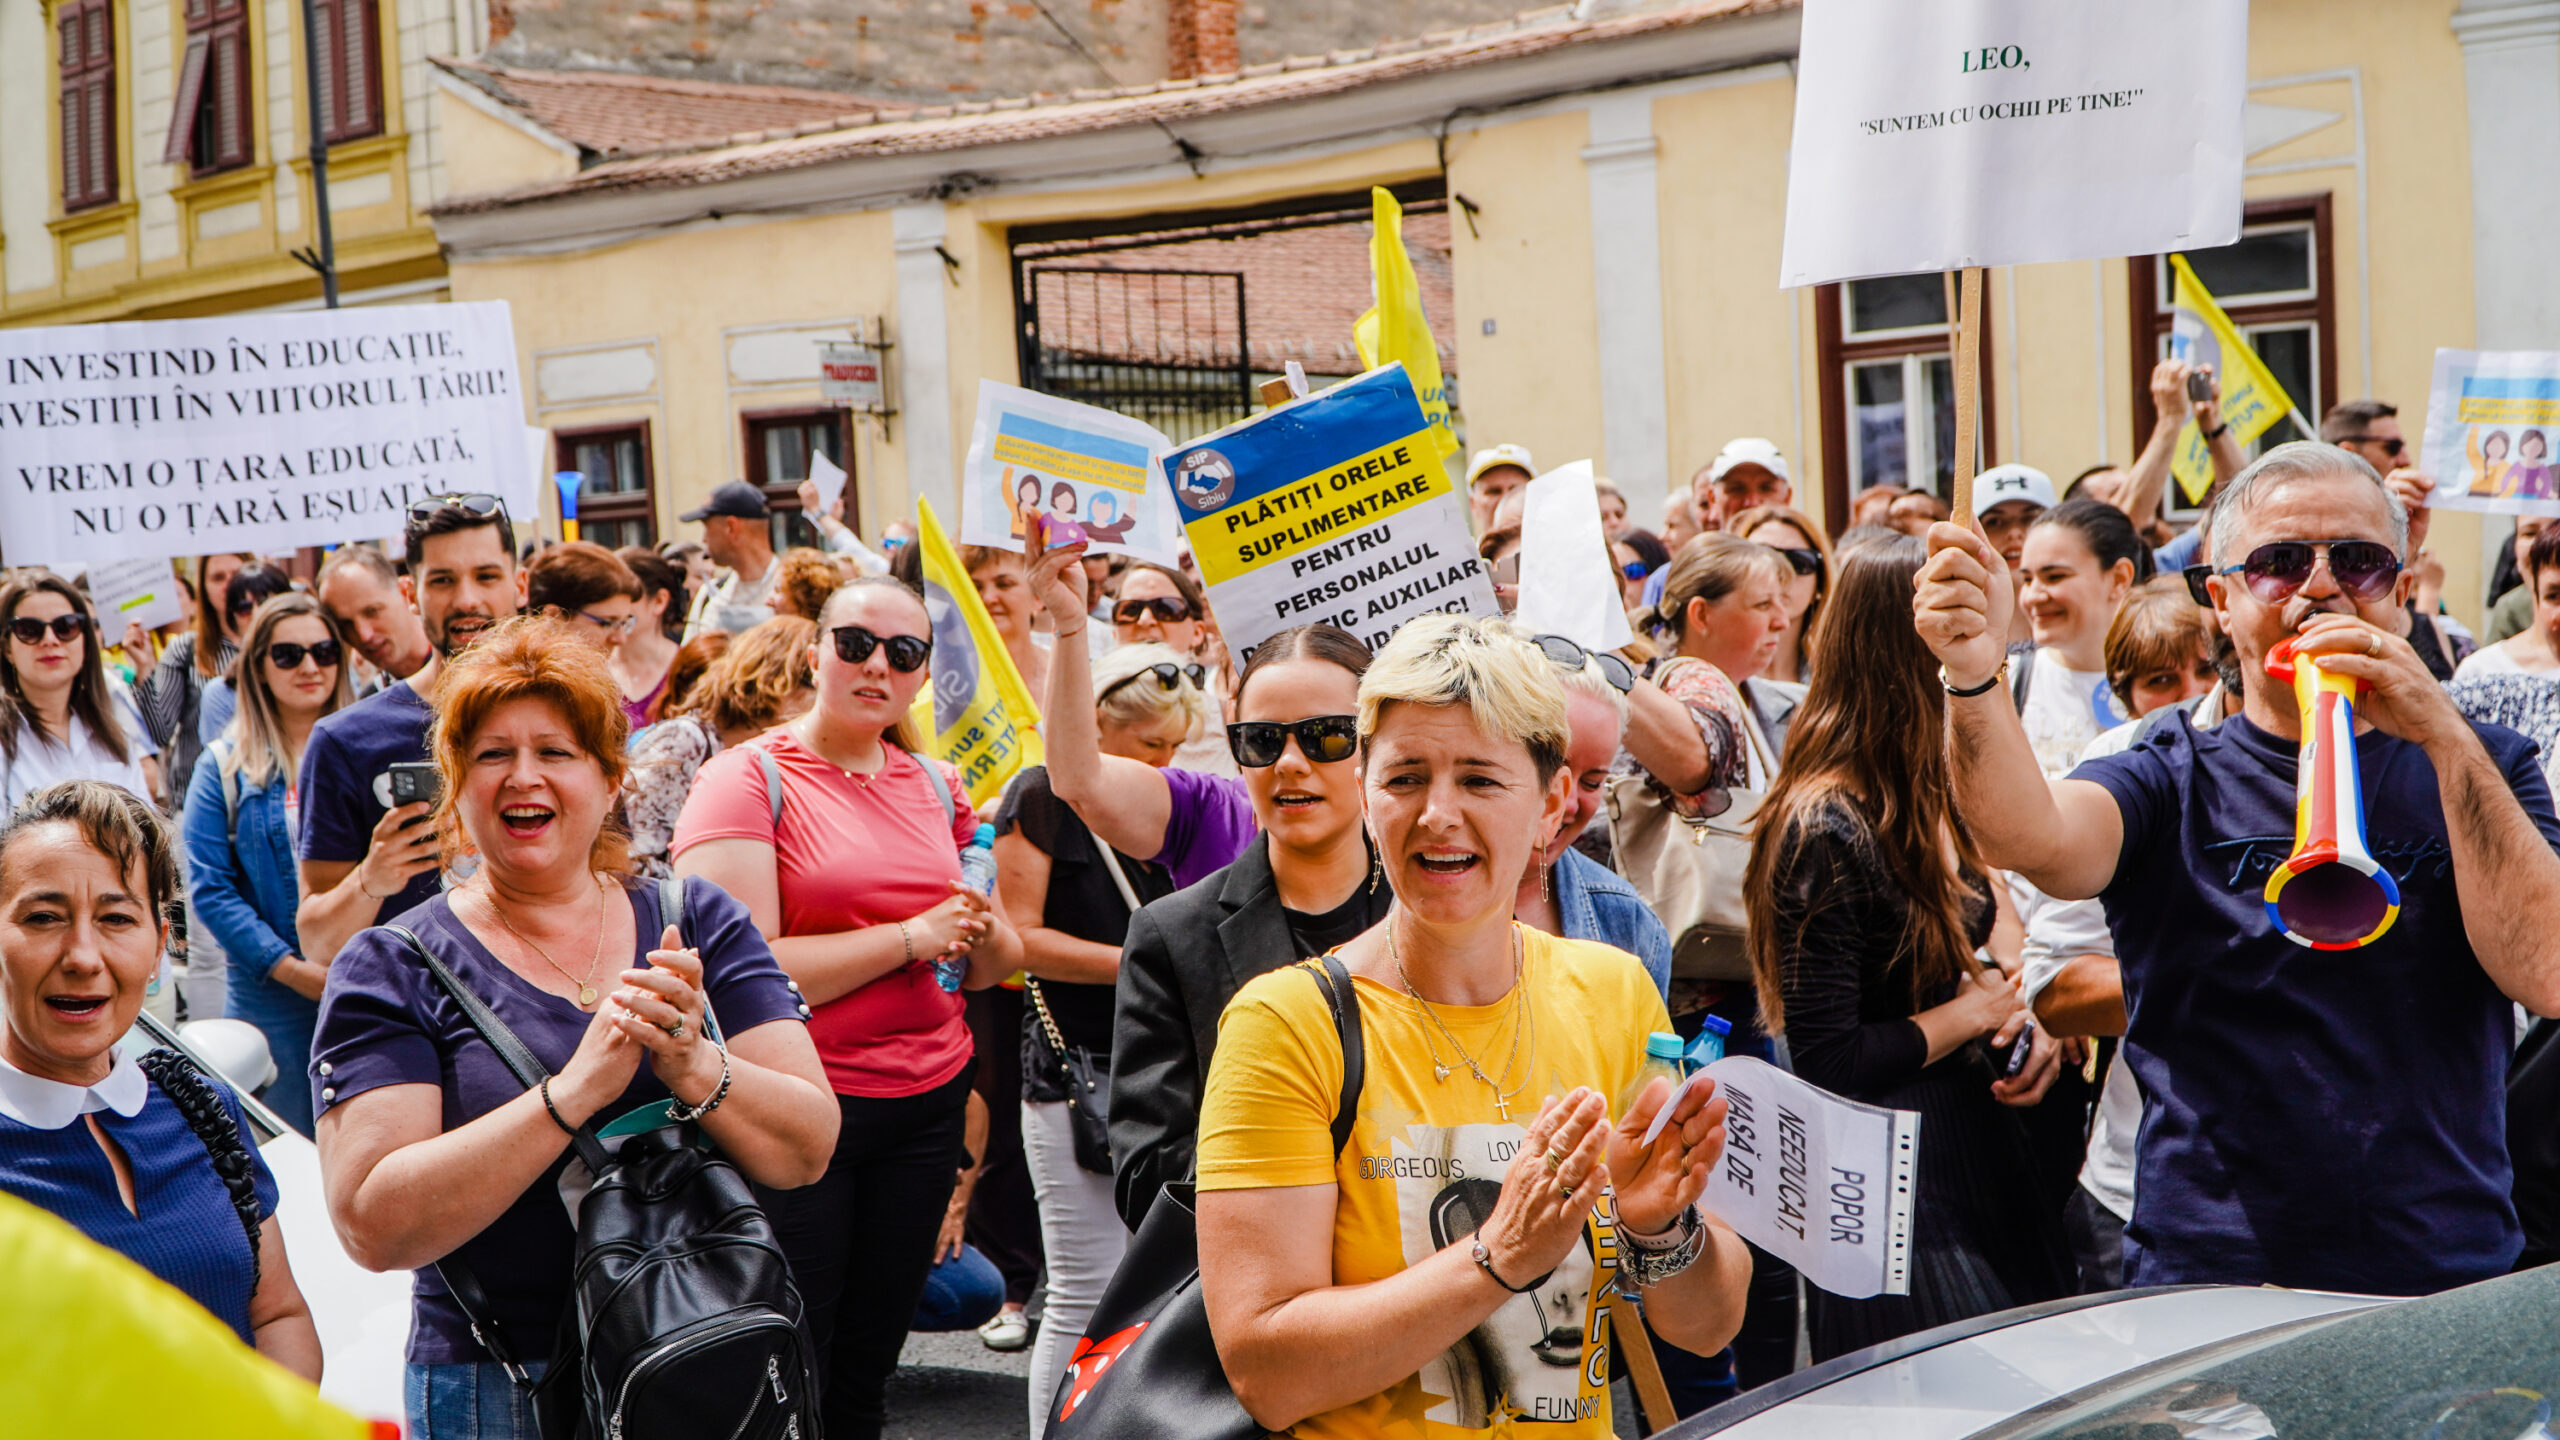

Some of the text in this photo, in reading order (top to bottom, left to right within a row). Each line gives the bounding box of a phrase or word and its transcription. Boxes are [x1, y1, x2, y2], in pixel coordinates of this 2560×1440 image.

[1961, 44, 2030, 73] LEO,
[1860, 88, 2143, 135] "SUNTEM CU OCHII PE TINE!"
[7, 330, 464, 385] INVESTIND ÎN EDUCAȚIE,
[173, 384, 213, 421] ÎN
[226, 376, 406, 417] VIITORUL
[411, 366, 507, 407] ȚĂRII!
[18, 428, 473, 494] VREM O ȚARA EDUCATĂ,
[1186, 451, 1208, 468] SIP
[73, 505, 124, 536] NU
[139, 503, 166, 532] O
[178, 488, 289, 535] ȚARĂ
[1198, 492, 1226, 508] Sibiu
[1225, 447, 1411, 533] PLĂTIȚI ORELE
[1239, 475, 1430, 563] SUPLIMENTARE
[1291, 525, 1392, 578] PENTRU
[1275, 543, 1439, 619] PERSONALUL
[1367, 558, 1481, 619] AUXILIAR
[1723, 1082, 1762, 1197] MASĂ DE
[1774, 1104, 1808, 1240] NEEDUCAT,
[1830, 1167, 1866, 1246] POPOR
[1535, 1394, 1600, 1420] FUNNY
